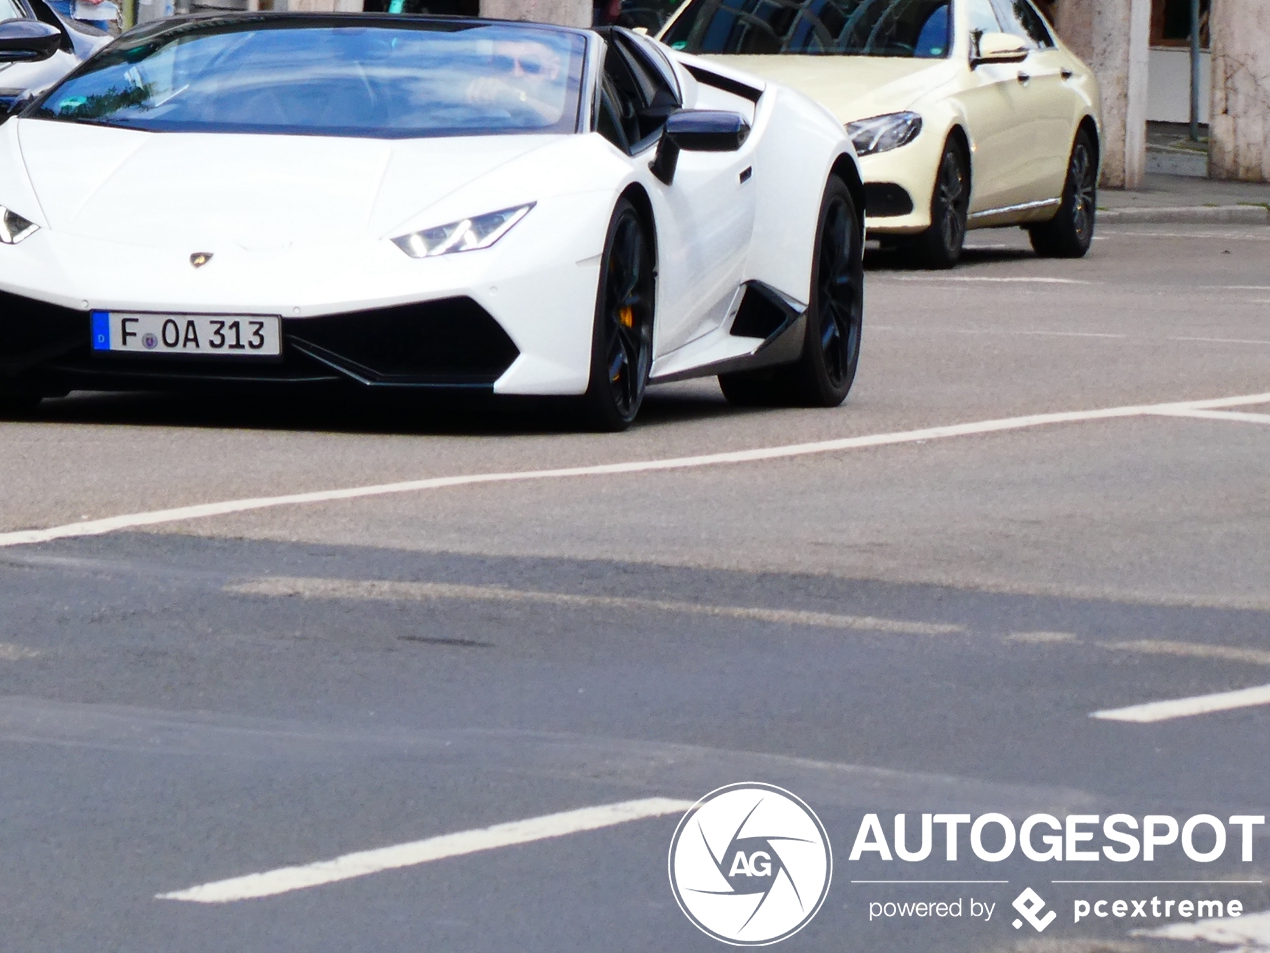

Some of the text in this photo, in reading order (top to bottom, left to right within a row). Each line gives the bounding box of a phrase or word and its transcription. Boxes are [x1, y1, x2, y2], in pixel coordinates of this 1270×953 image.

[121, 318, 265, 349] F OA 313
